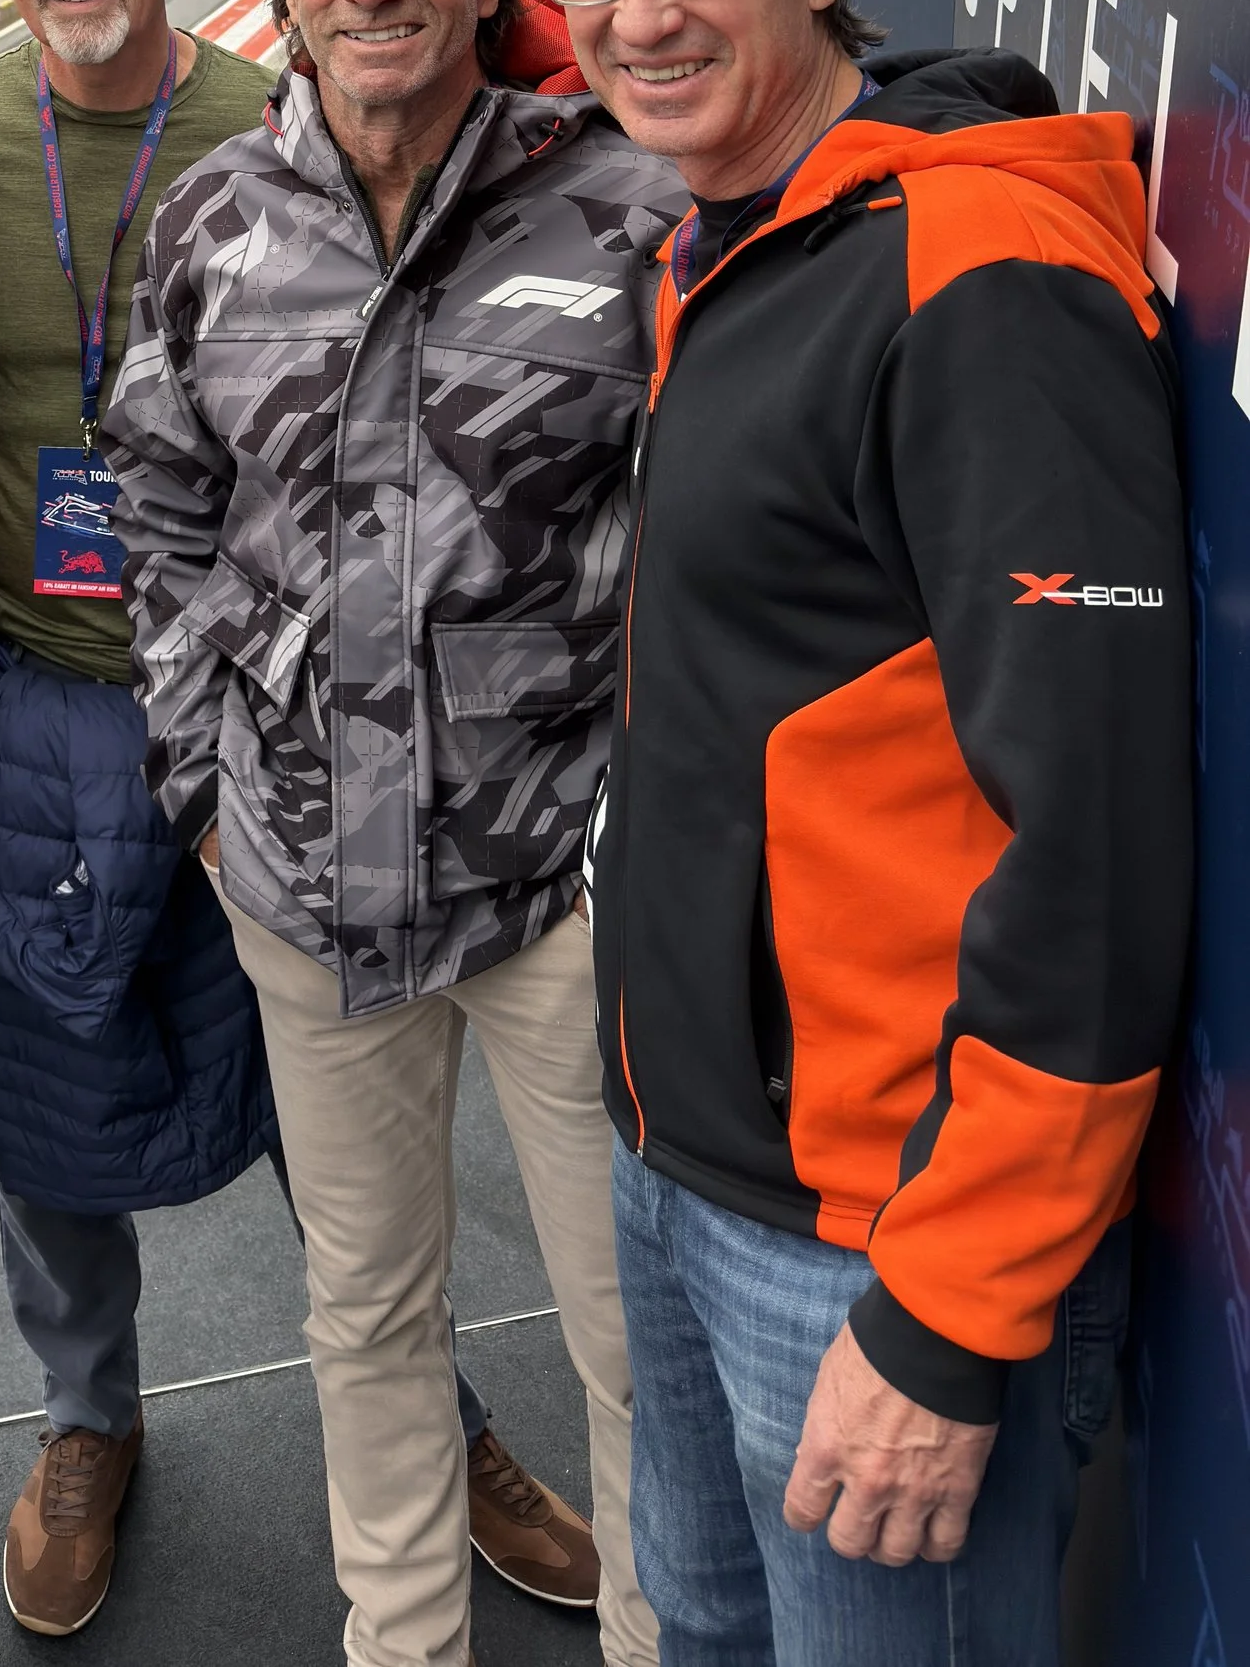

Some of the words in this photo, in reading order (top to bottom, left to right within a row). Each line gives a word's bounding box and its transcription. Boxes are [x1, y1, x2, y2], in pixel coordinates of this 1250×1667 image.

[46, 144, 63, 219] REDBULLRING.COM
[122, 145, 153, 221] REDBULLRING.COM
[1009, 572, 1164, 608] X-BOW
